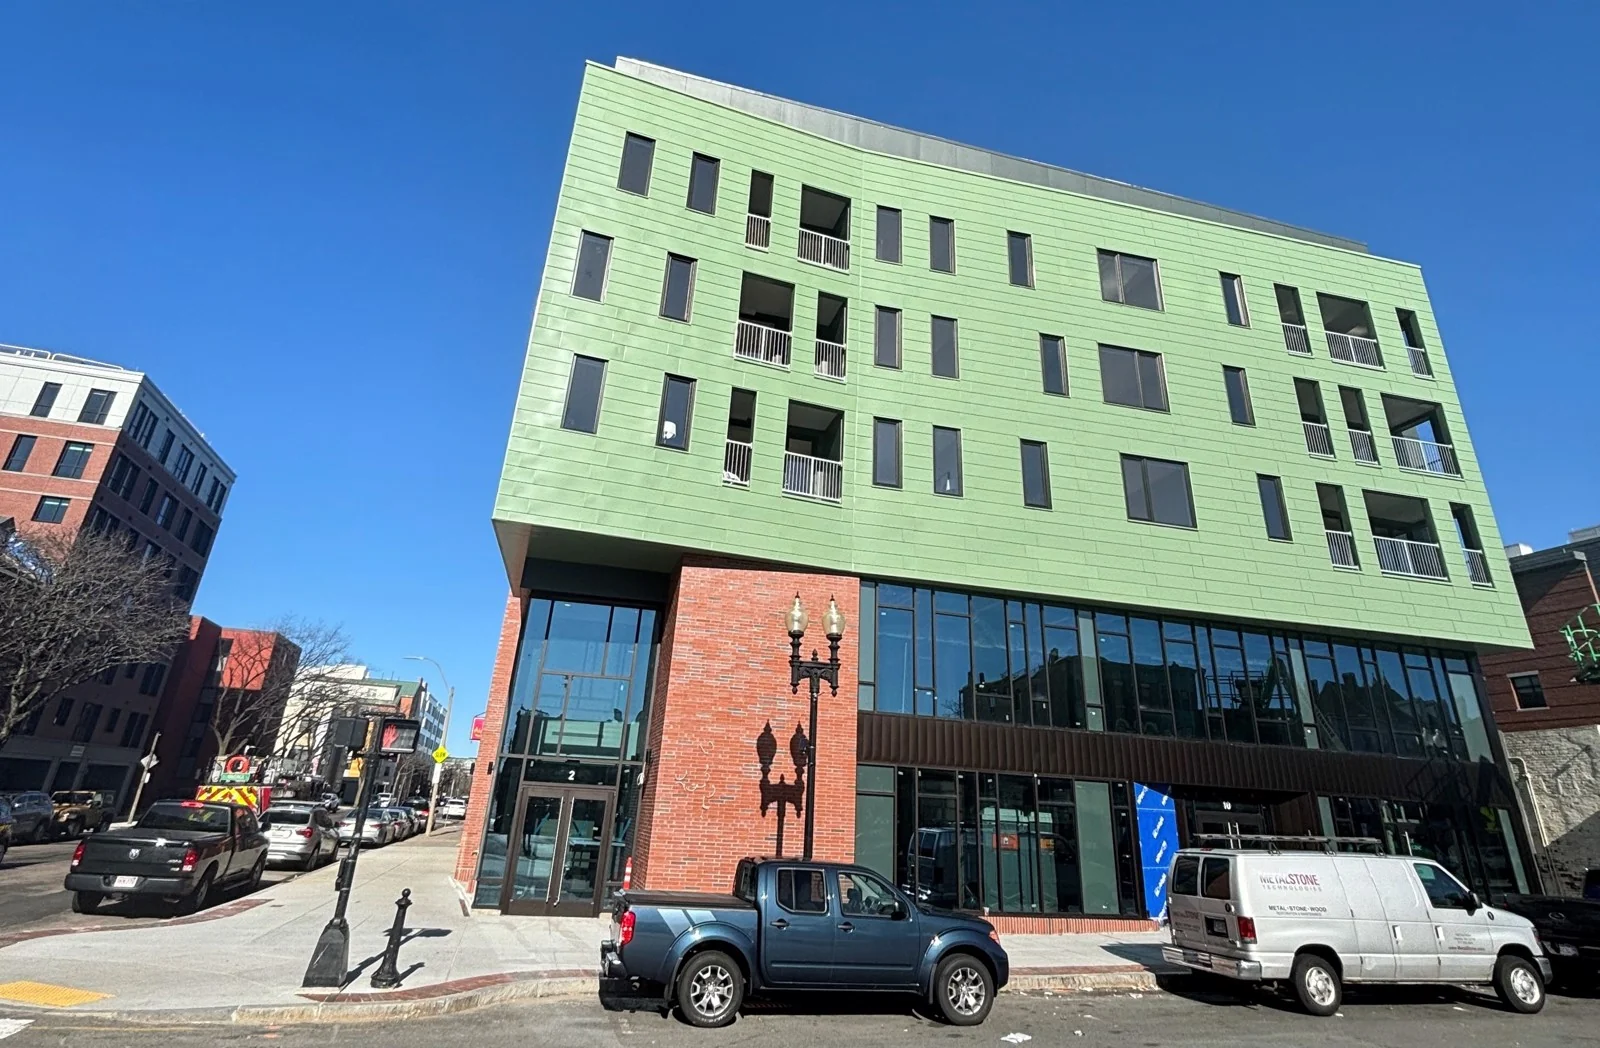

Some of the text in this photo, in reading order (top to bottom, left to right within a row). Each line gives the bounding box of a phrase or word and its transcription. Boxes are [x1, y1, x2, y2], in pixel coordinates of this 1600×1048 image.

[568, 769, 576, 781] 2
[1222, 800, 1232, 810] 10
[1262, 884, 1323, 892] TECHNOLOGIES
